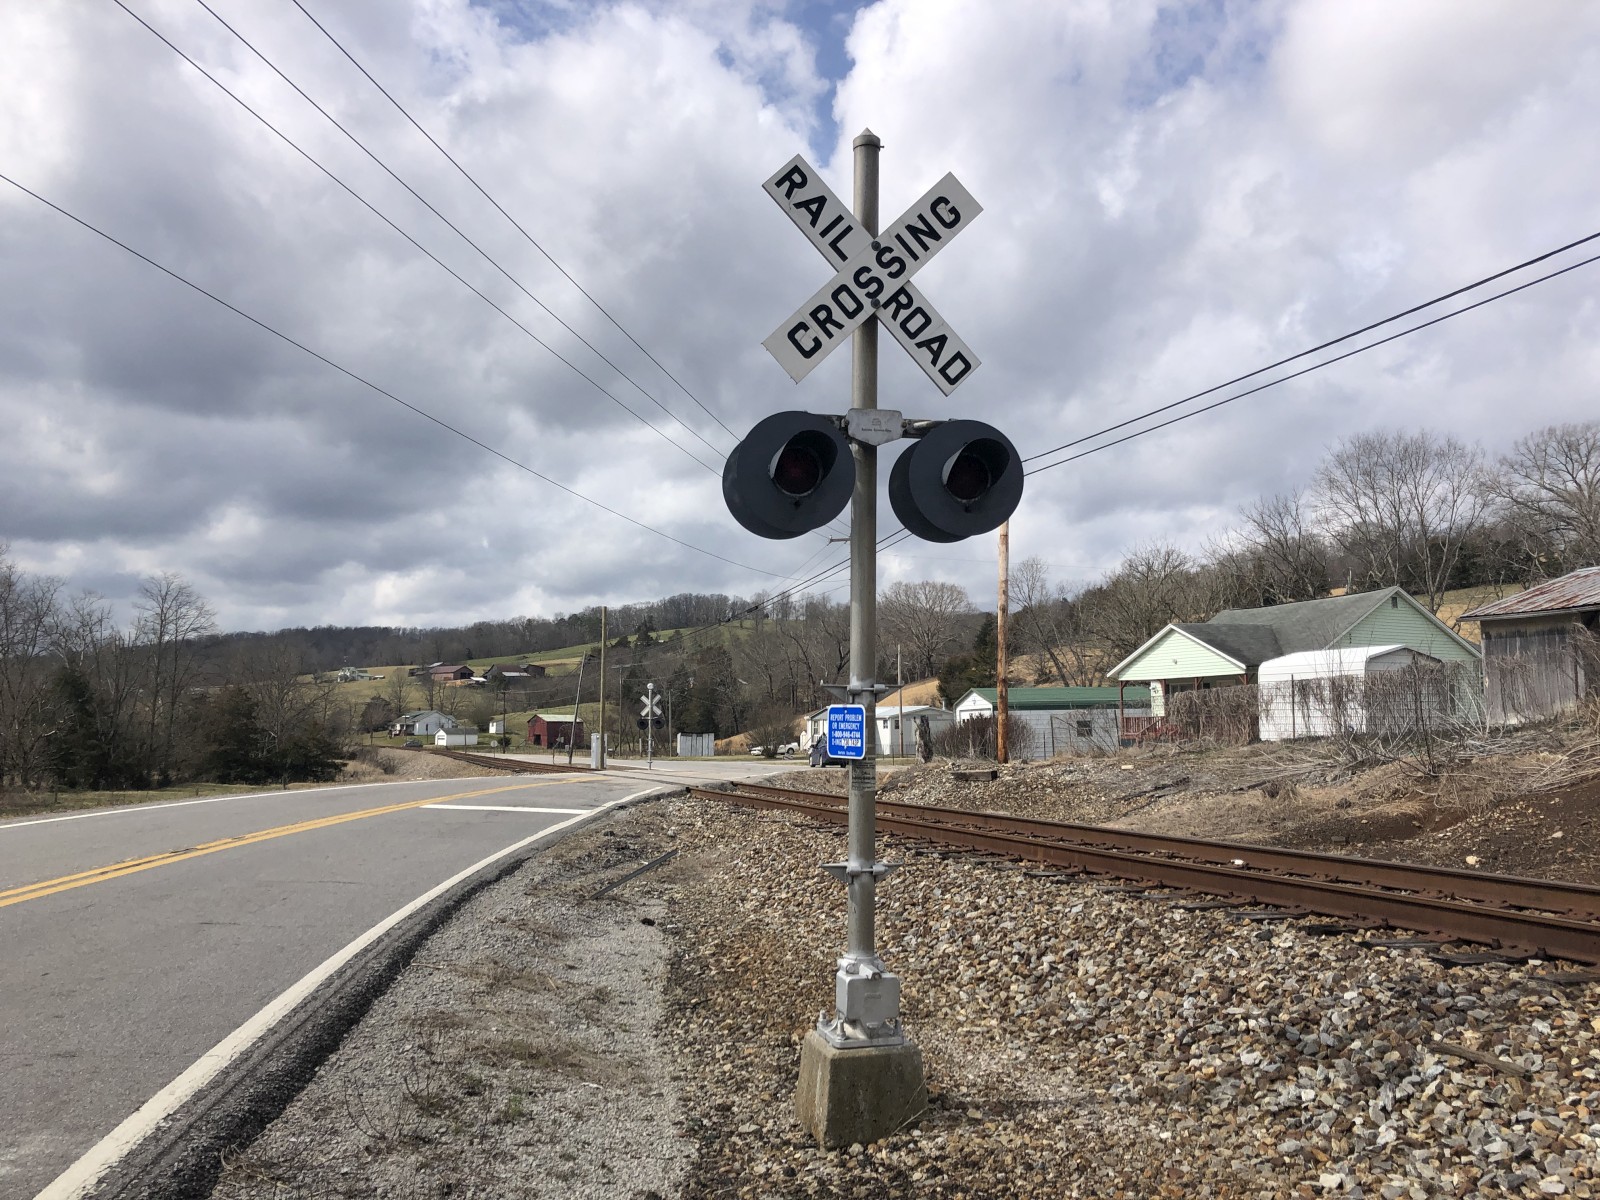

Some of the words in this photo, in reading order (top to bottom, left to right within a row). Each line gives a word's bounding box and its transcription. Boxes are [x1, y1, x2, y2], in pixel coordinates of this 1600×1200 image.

[774, 164, 854, 262] RAIL
[881, 286, 972, 386] ROAD
[787, 196, 961, 359] CROSSING
[838, 722, 860, 730] EMERGENCY
